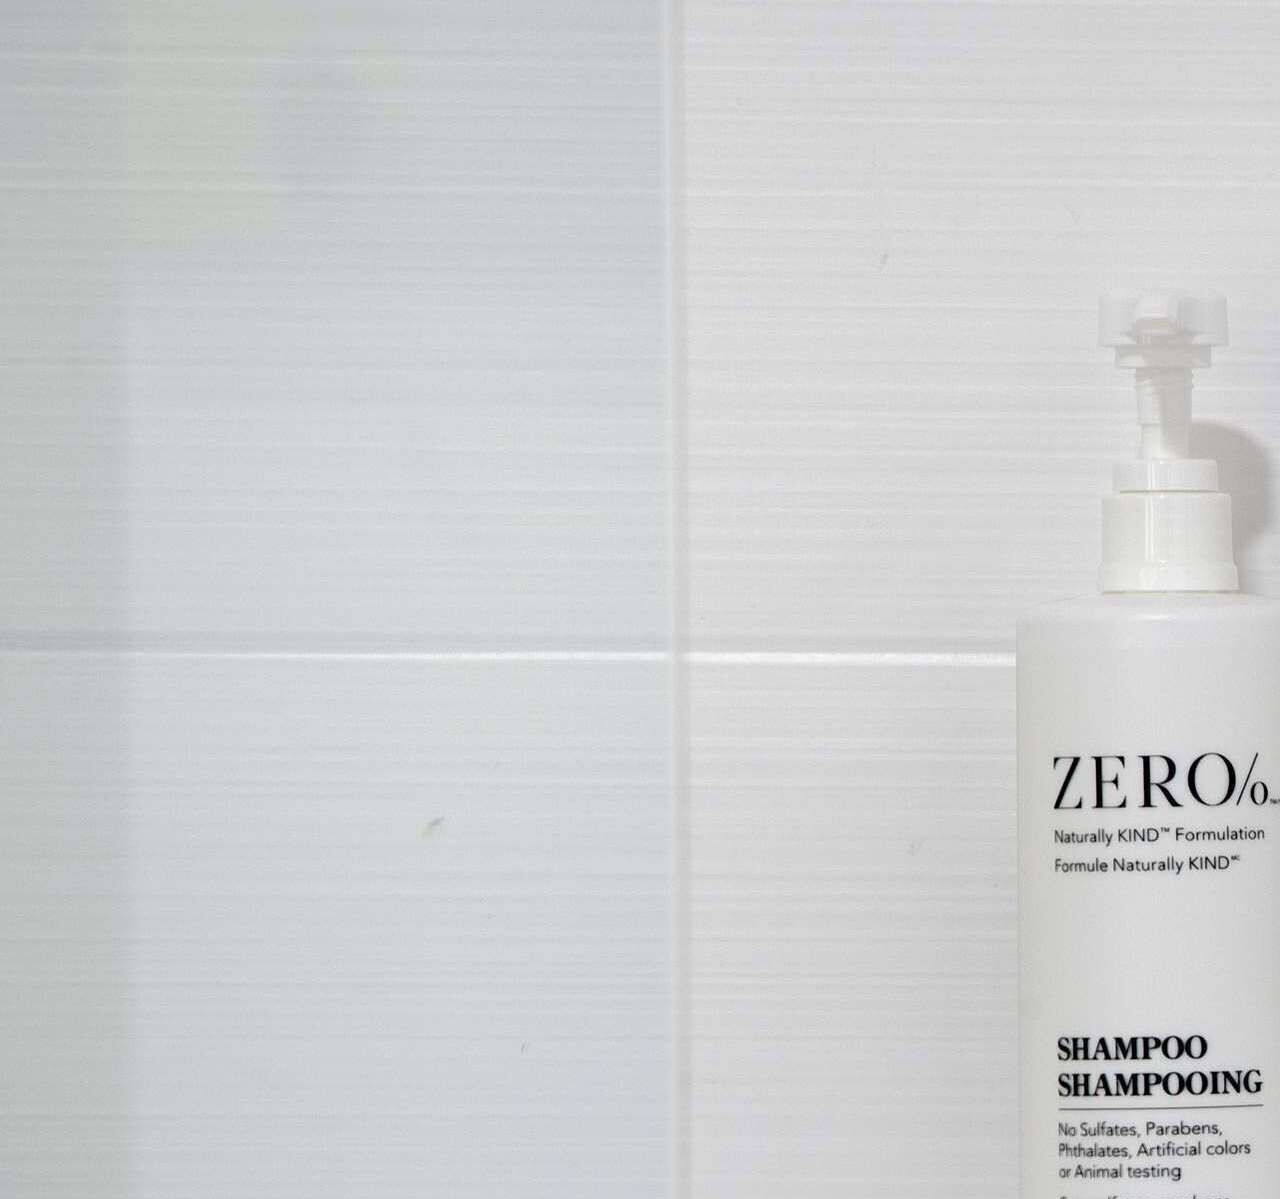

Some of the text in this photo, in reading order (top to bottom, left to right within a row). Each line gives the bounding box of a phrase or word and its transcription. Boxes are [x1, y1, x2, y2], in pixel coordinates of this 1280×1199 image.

[1054, 829, 1112, 846] Naturally
[1175, 826, 1265, 842] Formulation
[1055, 858, 1108, 873] Formule
[1113, 858, 1184, 875] Naturally
[1057, 1034, 1208, 1061] SHAMPOO
[1057, 1069, 1263, 1097] SHAMPOOING
[1058, 1121, 1223, 1138] No Sulfates, Parabens,
[1059, 1140, 1251, 1159] Phthalates, Artificial colors
[1059, 1164, 1182, 1181] or Animal testing
